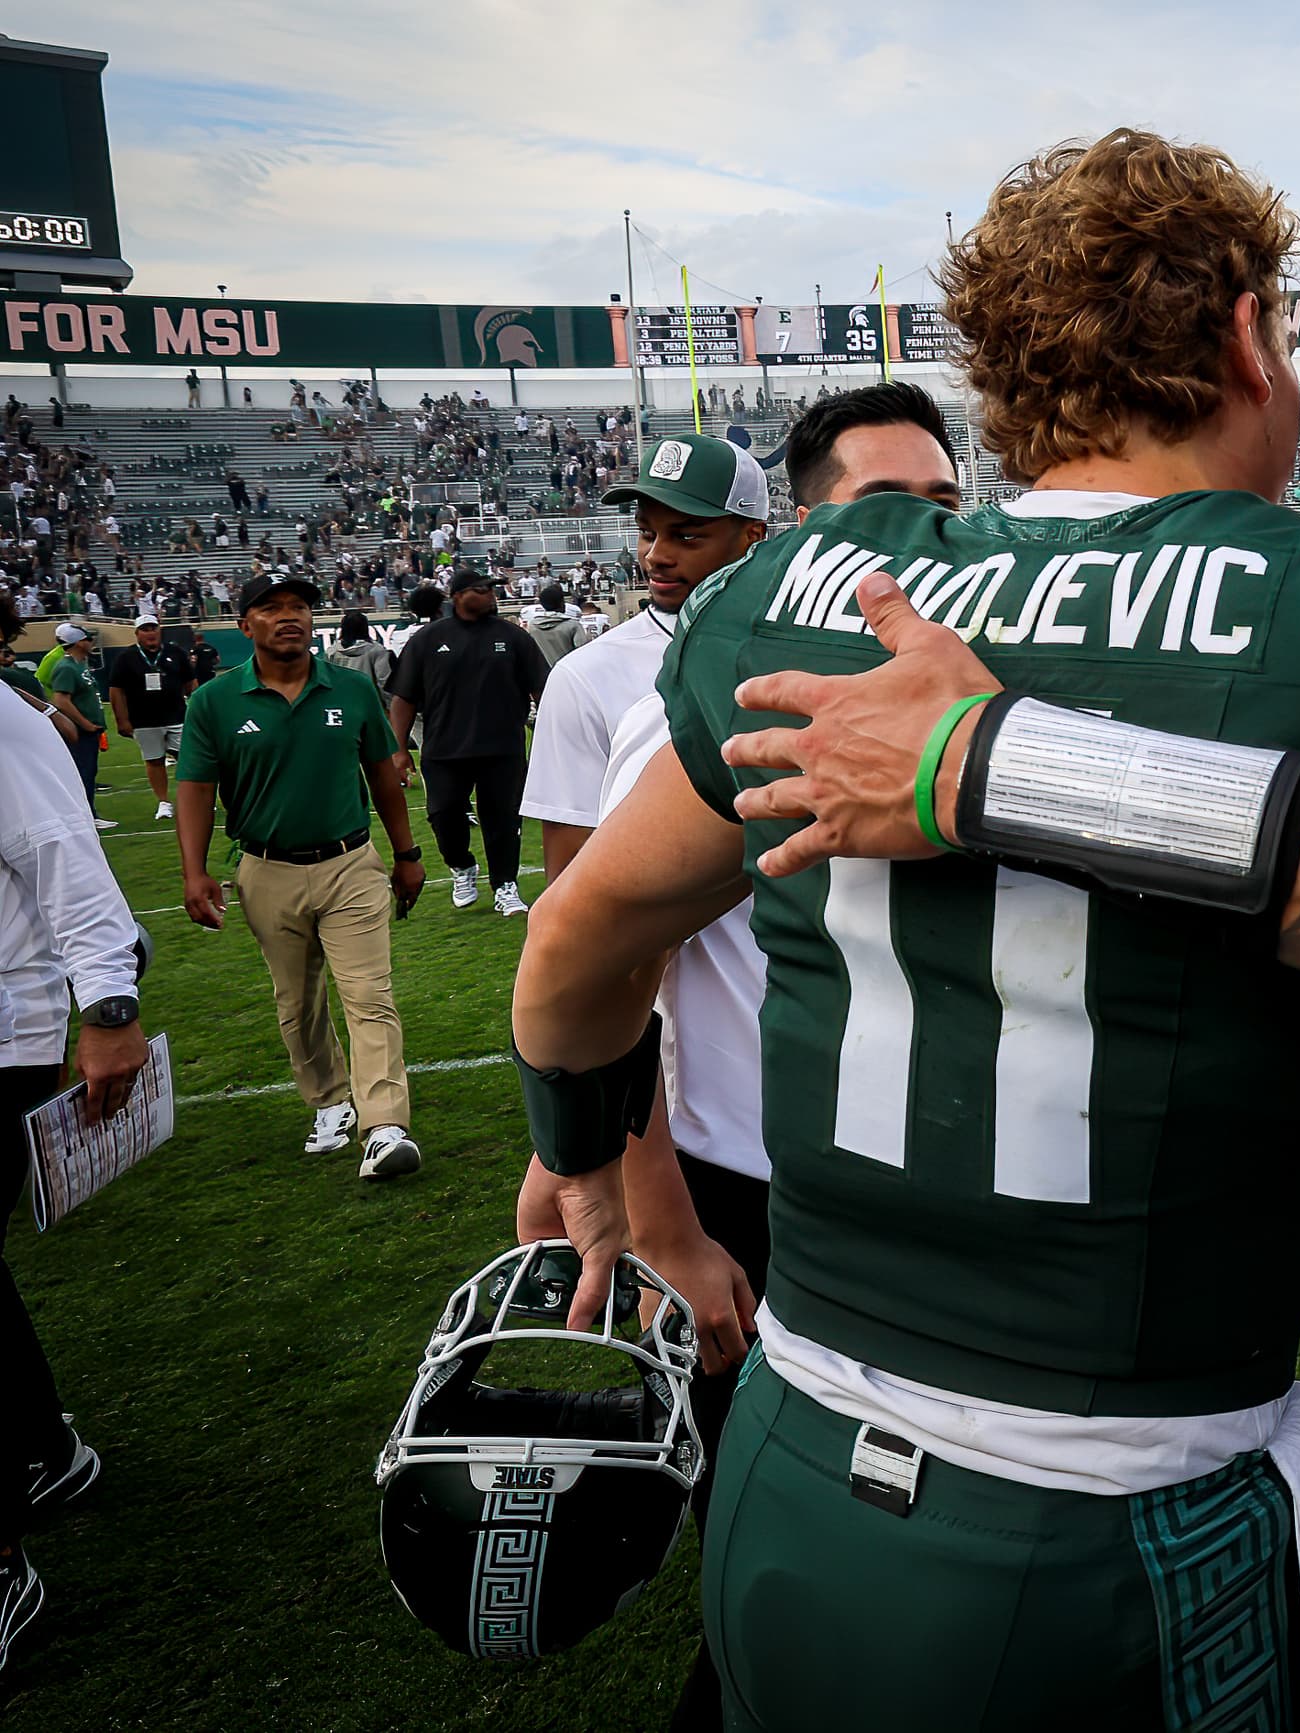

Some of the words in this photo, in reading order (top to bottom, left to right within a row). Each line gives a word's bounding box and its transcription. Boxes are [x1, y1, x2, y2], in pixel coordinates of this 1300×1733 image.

[637, 316, 651, 326] 13
[669, 316, 687, 325] 1ST
[690, 316, 727, 325] DOWNS
[778, 310, 792, 323] E
[911, 312, 929, 322] 1ST
[5, 301, 131, 354] FOR
[155, 306, 281, 357] MSU
[641, 329, 649, 339] 3
[775, 330, 791, 352] 7
[846, 329, 877, 351] 35
[639, 342, 652, 352] 12
[663, 342, 705, 352] PENATY
[706, 341, 737, 351] YARDS
[665, 355, 690, 364] TIME
[694, 355, 707, 363] OF
[708, 354, 738, 363] POSS.
[907, 350, 932, 360] TIME
[324, 708, 343, 726] E
[490, 1465, 556, 1490] STATE
